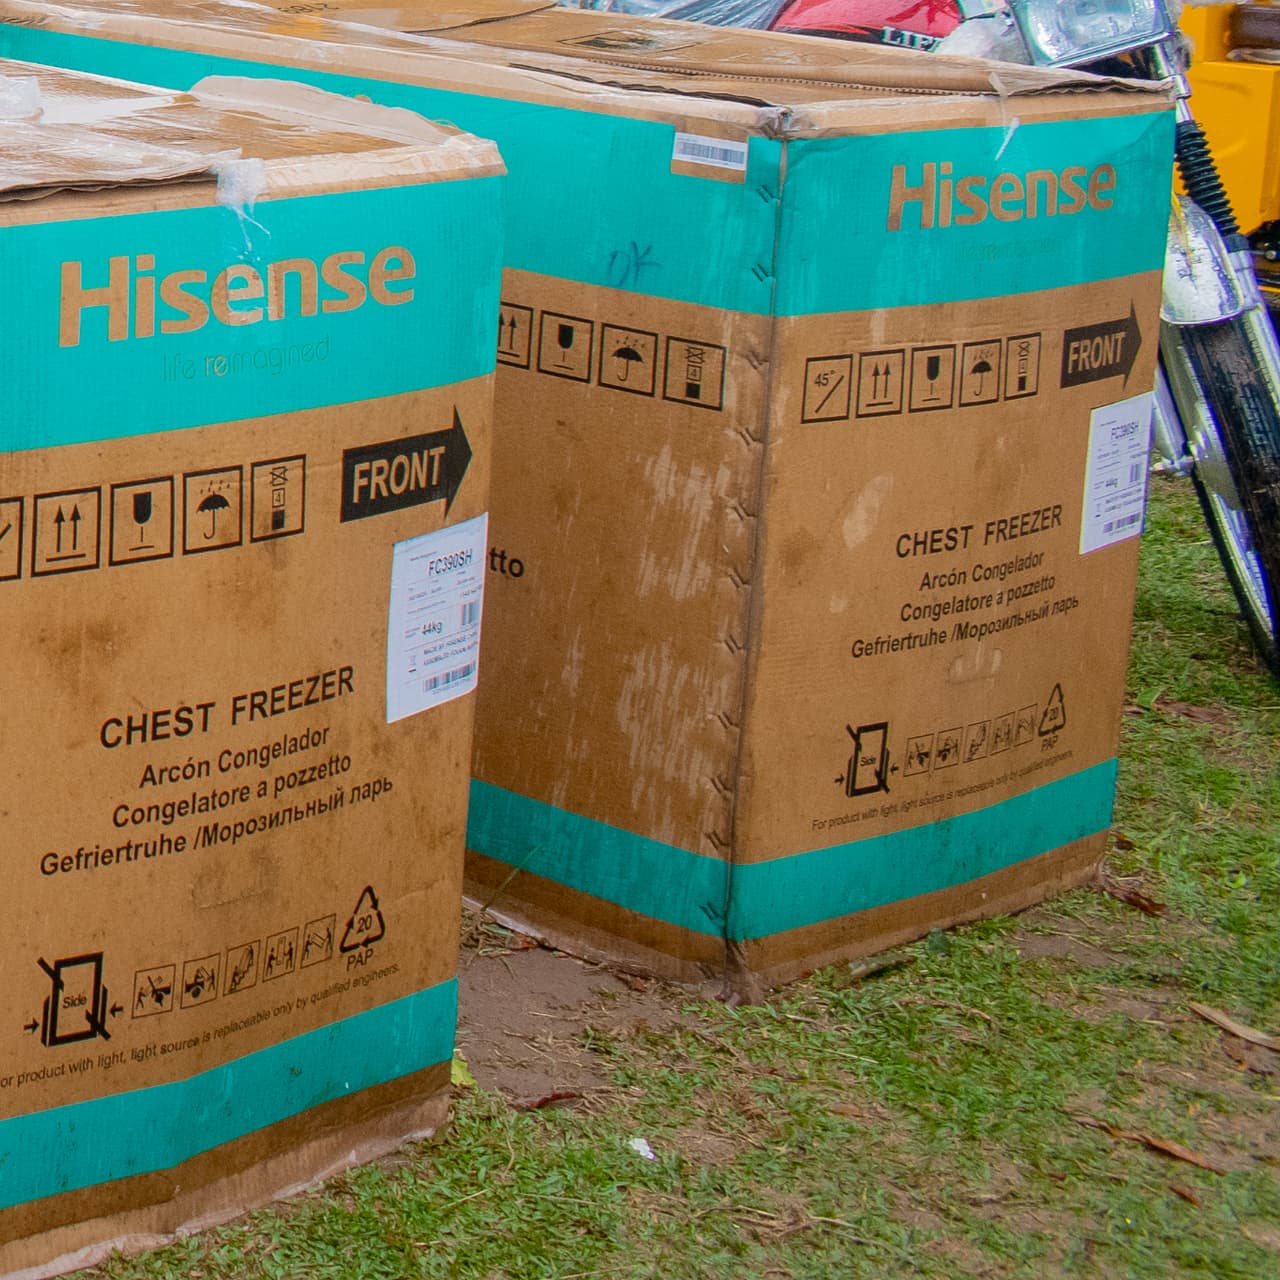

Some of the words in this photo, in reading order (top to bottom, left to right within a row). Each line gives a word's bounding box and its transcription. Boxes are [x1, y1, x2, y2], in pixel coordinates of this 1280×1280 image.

[886, 161, 1117, 232] Hisense
[58, 246, 417, 348] Hisense
[204, 337, 331, 379] reimagined
[1068, 331, 1126, 375] FRONT
[352, 445, 446, 505] FRONT
[896, 524, 974, 559] CHEST
[983, 504, 1063, 547] FREEZER
[428, 548, 472, 577] FC390SH
[919, 567, 968, 593] Arcón
[971, 550, 1045, 584] Congelador
[851, 627, 948, 659] Gefriertruhe
[1051, 593, 1080, 617] ларь
[900, 593, 994, 622] Congelatore
[996, 593, 1004, 605] a
[1006, 573, 1056, 607] pozzetto
[99, 701, 216, 750] CHEST
[231, 665, 355, 725] FREEZER
[139, 753, 211, 789] Arcón
[218, 724, 331, 775] Congelador
[112, 782, 252, 829] Congelatore
[256, 779, 269, 799] a
[272, 752, 354, 797] pozzetto
[39, 833, 187, 877] Gefriertruhe
[349, 773, 394, 808] ларь
[345, 947, 375, 972] PAP
[62, 993, 88, 1010] Side
[17, 1060, 66, 1086] product
[69, 1057, 94, 1074] with
[130, 1043, 158, 1064] light
[159, 1036, 200, 1055] source
[201, 1030, 211, 1044] is
[213, 1005, 273, 1040] replaceable
[272, 1001, 294, 1023] only
[295, 992, 309, 1013] by
[310, 979, 352, 1010] qualified
